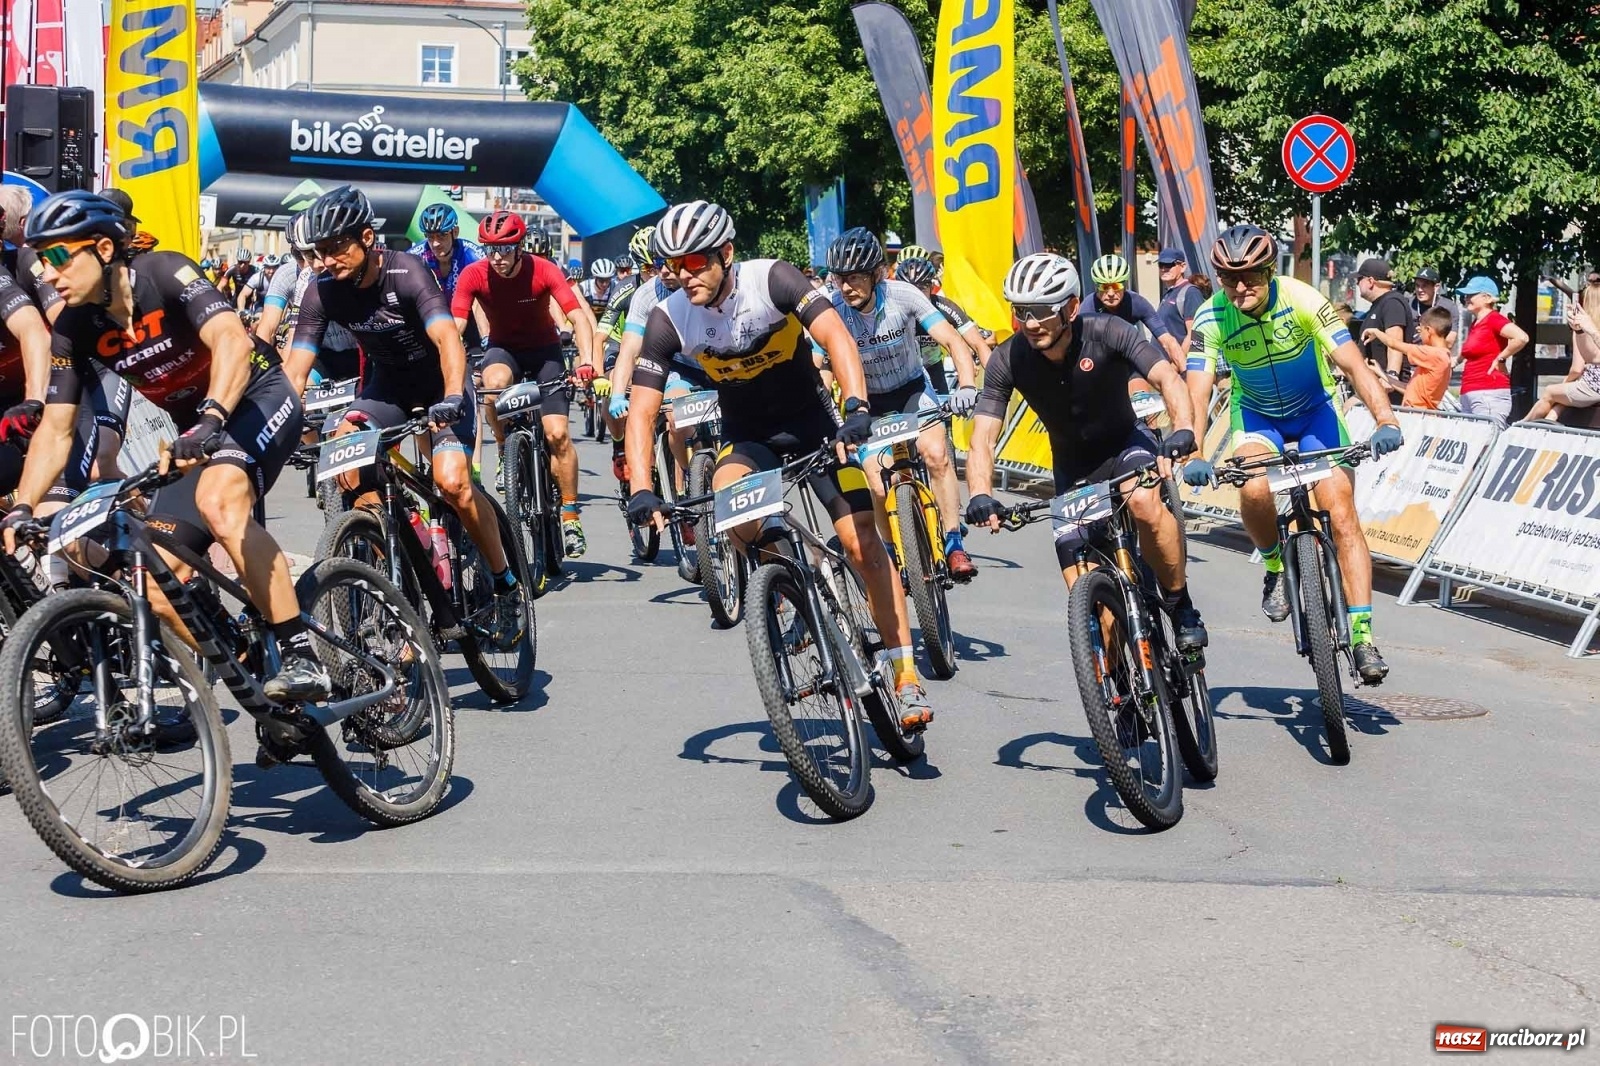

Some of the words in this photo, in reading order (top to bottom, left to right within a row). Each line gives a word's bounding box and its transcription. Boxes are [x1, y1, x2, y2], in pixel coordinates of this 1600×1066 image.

[291, 119, 363, 154] bike
[372, 127, 480, 161] atelier
[96, 308, 165, 357] CST
[869, 327, 906, 346] atelier
[505, 394, 531, 410] 1971
[681, 399, 711, 416] 1007
[874, 420, 908, 437] 1002
[328, 443, 366, 465] 1005
[1415, 435, 1460, 463] TAURUS
[1420, 480, 1451, 499] Taurus
[1482, 445, 1600, 517] TAURUS
[728, 486, 767, 512] 1517
[1061, 494, 1100, 518] 1145
[60, 498, 103, 529] 1546
[1515, 521, 1572, 543] gdziekolwiek
[1567, 528, 1600, 550] jedzies
